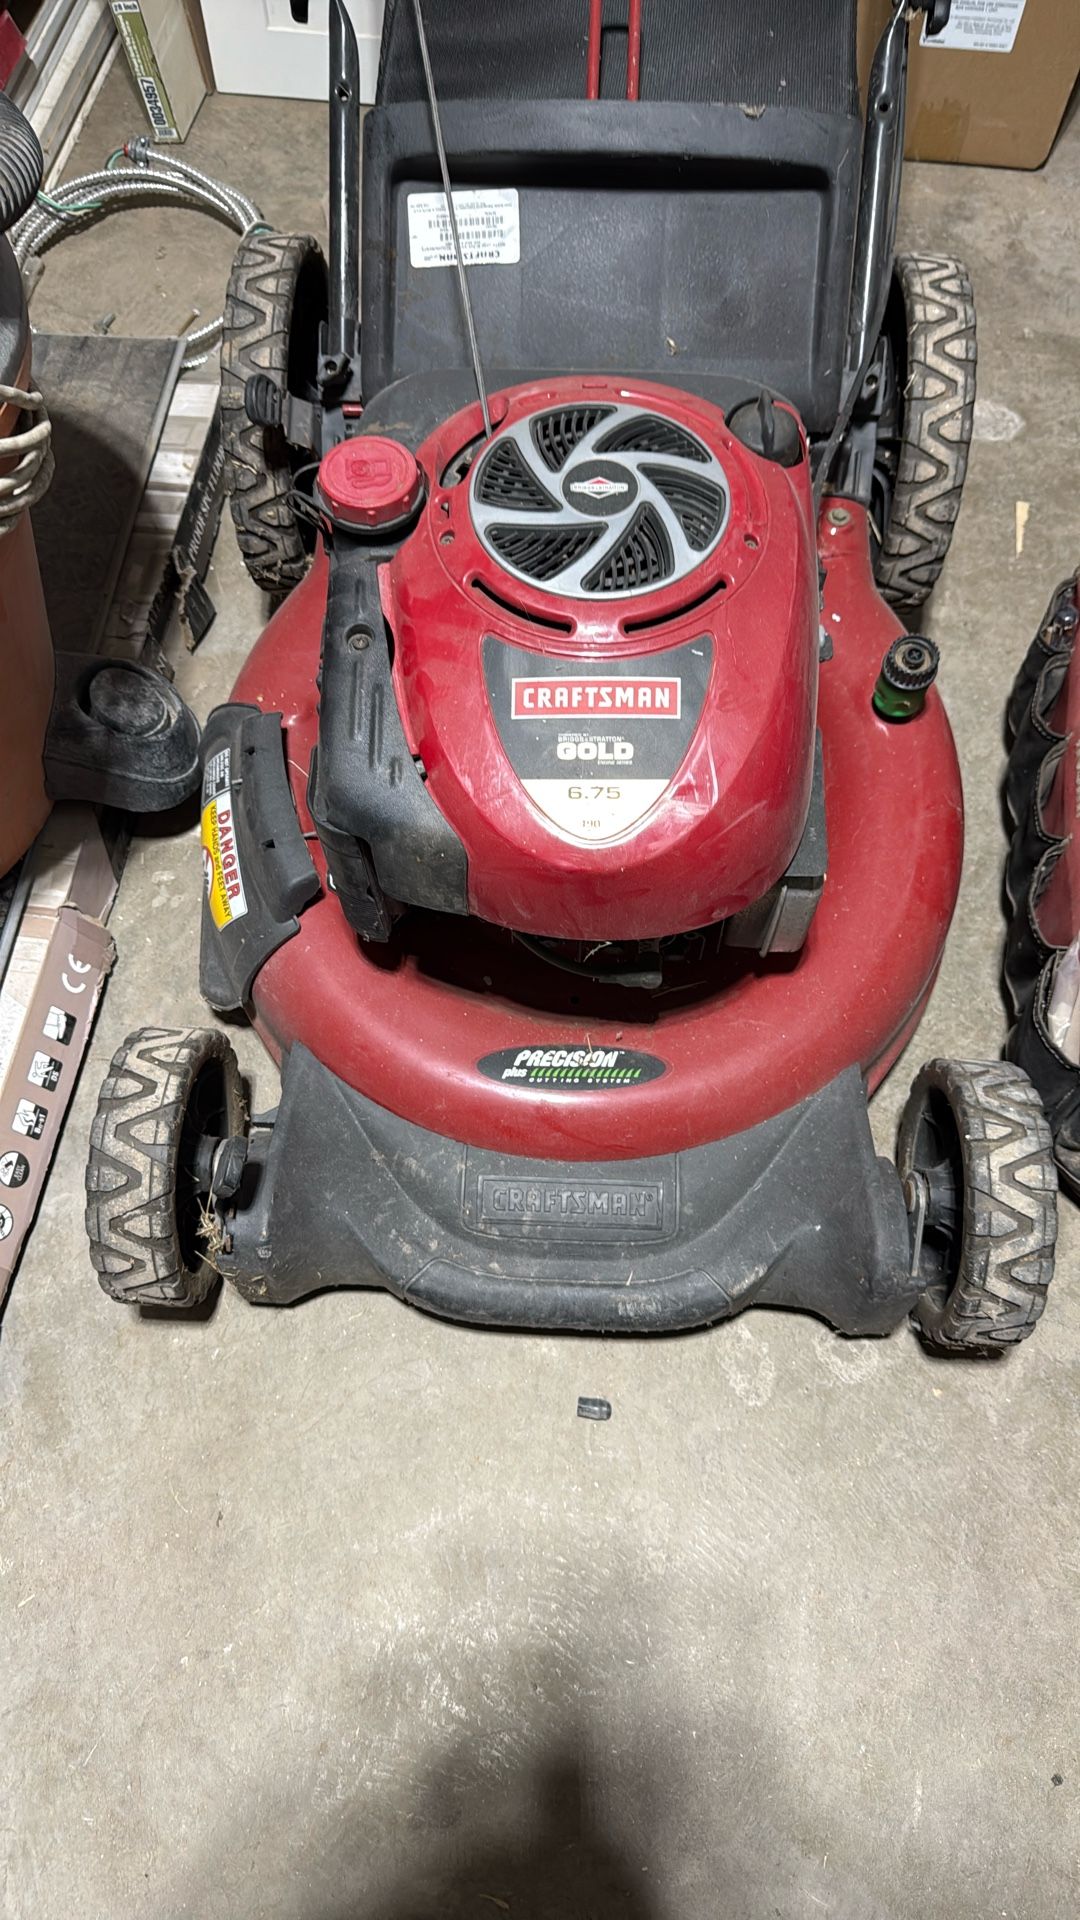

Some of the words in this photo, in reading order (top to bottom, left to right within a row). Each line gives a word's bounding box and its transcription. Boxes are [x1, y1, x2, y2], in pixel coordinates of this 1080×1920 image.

[140, 79, 167, 126] 0034957
[523, 686, 670, 709] CRAFTSMAN
[557, 742, 634, 760] GOLD
[568, 786, 621, 800] 6.75
[211, 827, 220, 855] HANDS
[218, 809, 240, 900] DANGER
[217, 870, 226, 892] FEET
[221, 893, 232, 918] AWAY
[514, 1049, 619, 1068] PRECISION
[501, 1066, 528, 1080] plus
[493, 1187, 647, 1217] CRAFTSMAN
